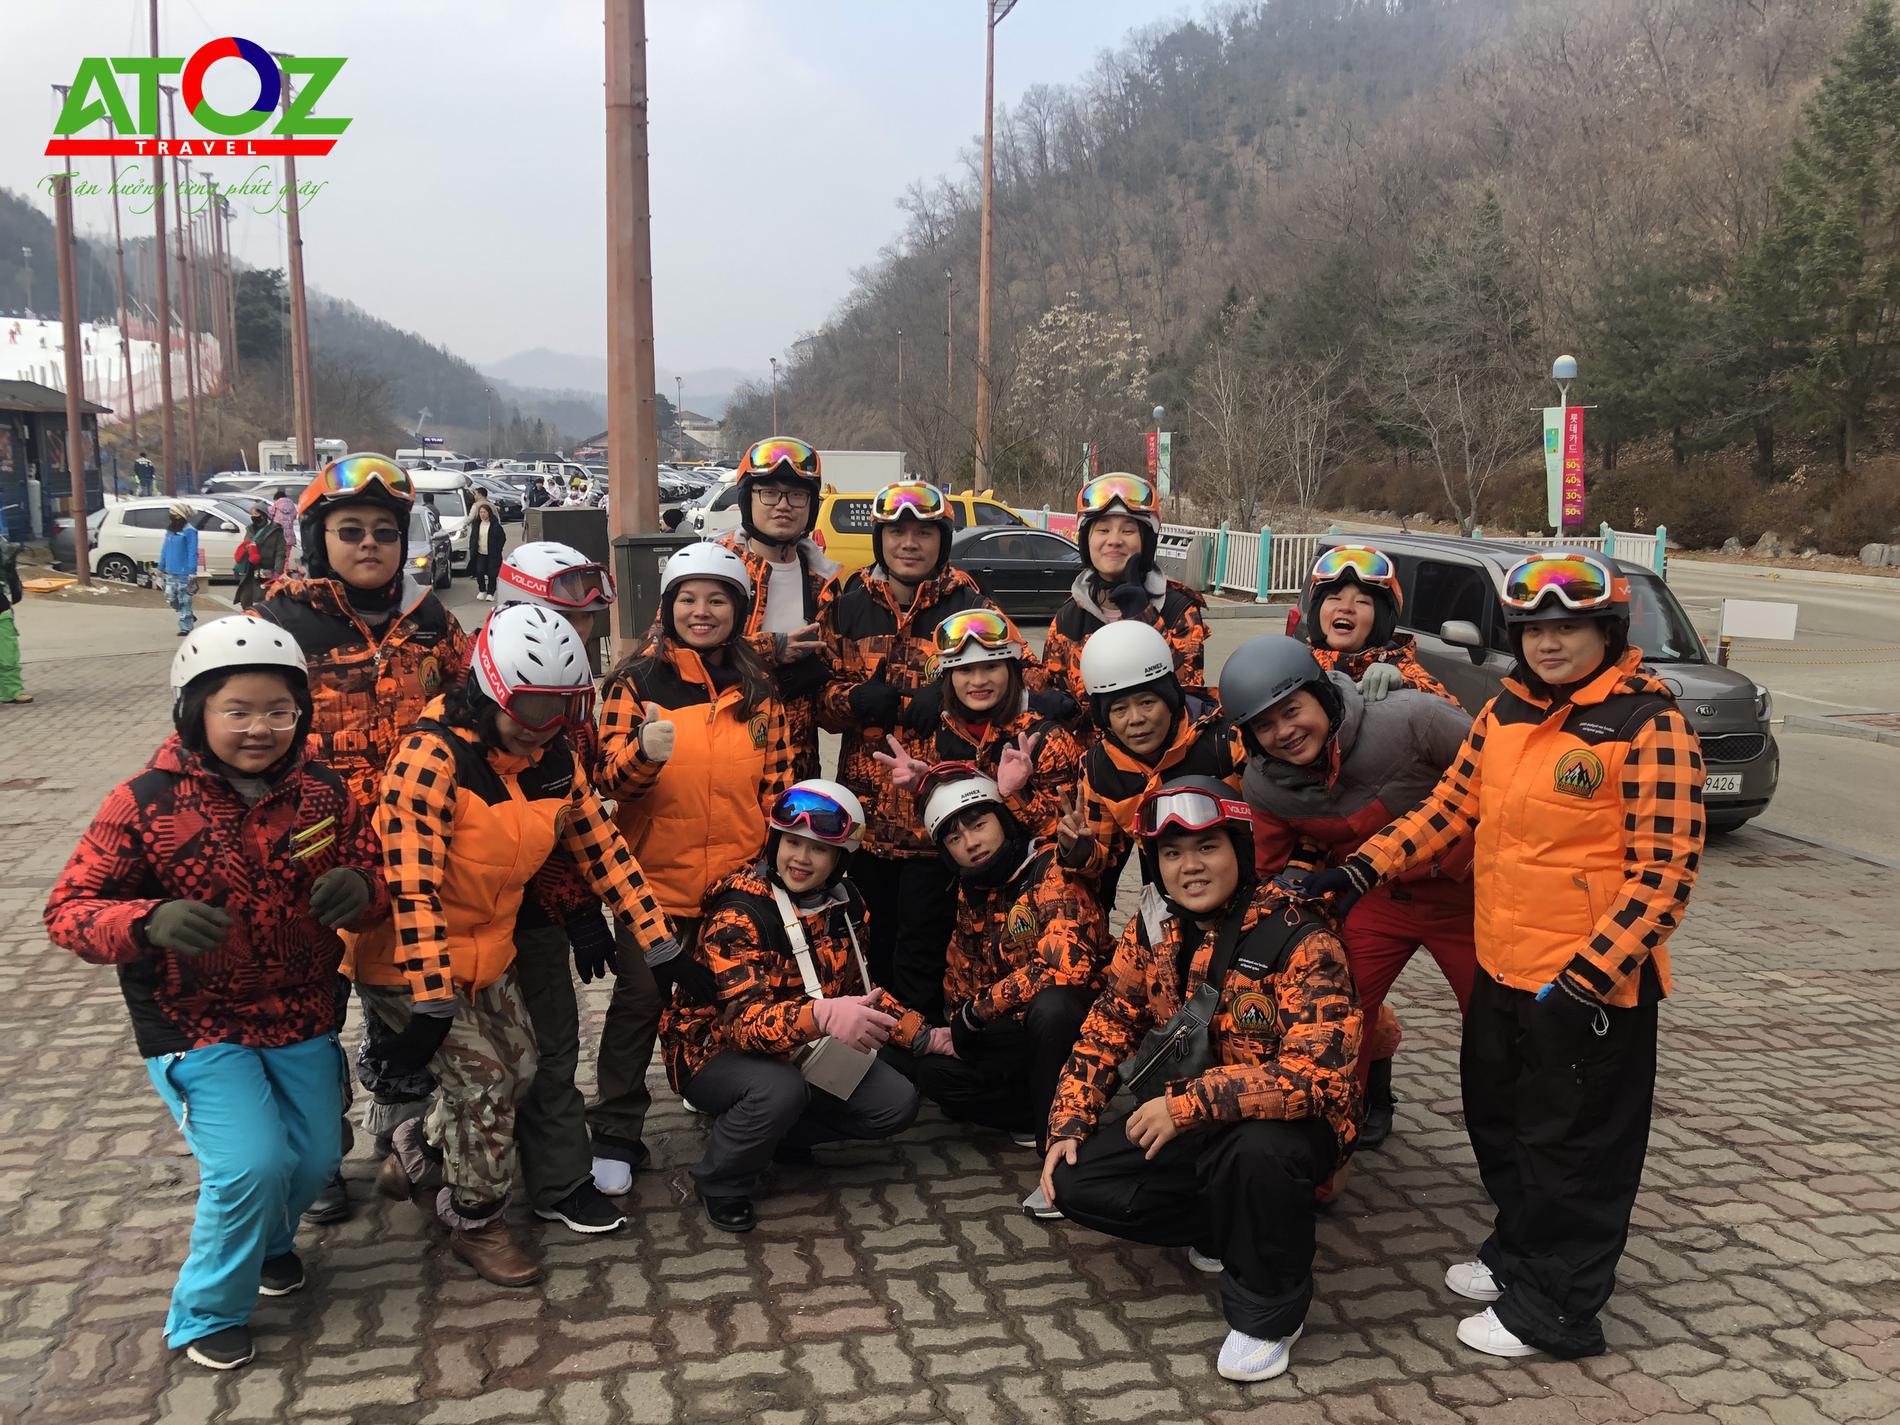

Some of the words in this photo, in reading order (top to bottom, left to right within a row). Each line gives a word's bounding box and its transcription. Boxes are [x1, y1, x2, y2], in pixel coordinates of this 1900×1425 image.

[511, 573, 547, 592] VOLCAN
[481, 648, 506, 700] VOLCAN
[1705, 777, 1735, 791] 9426
